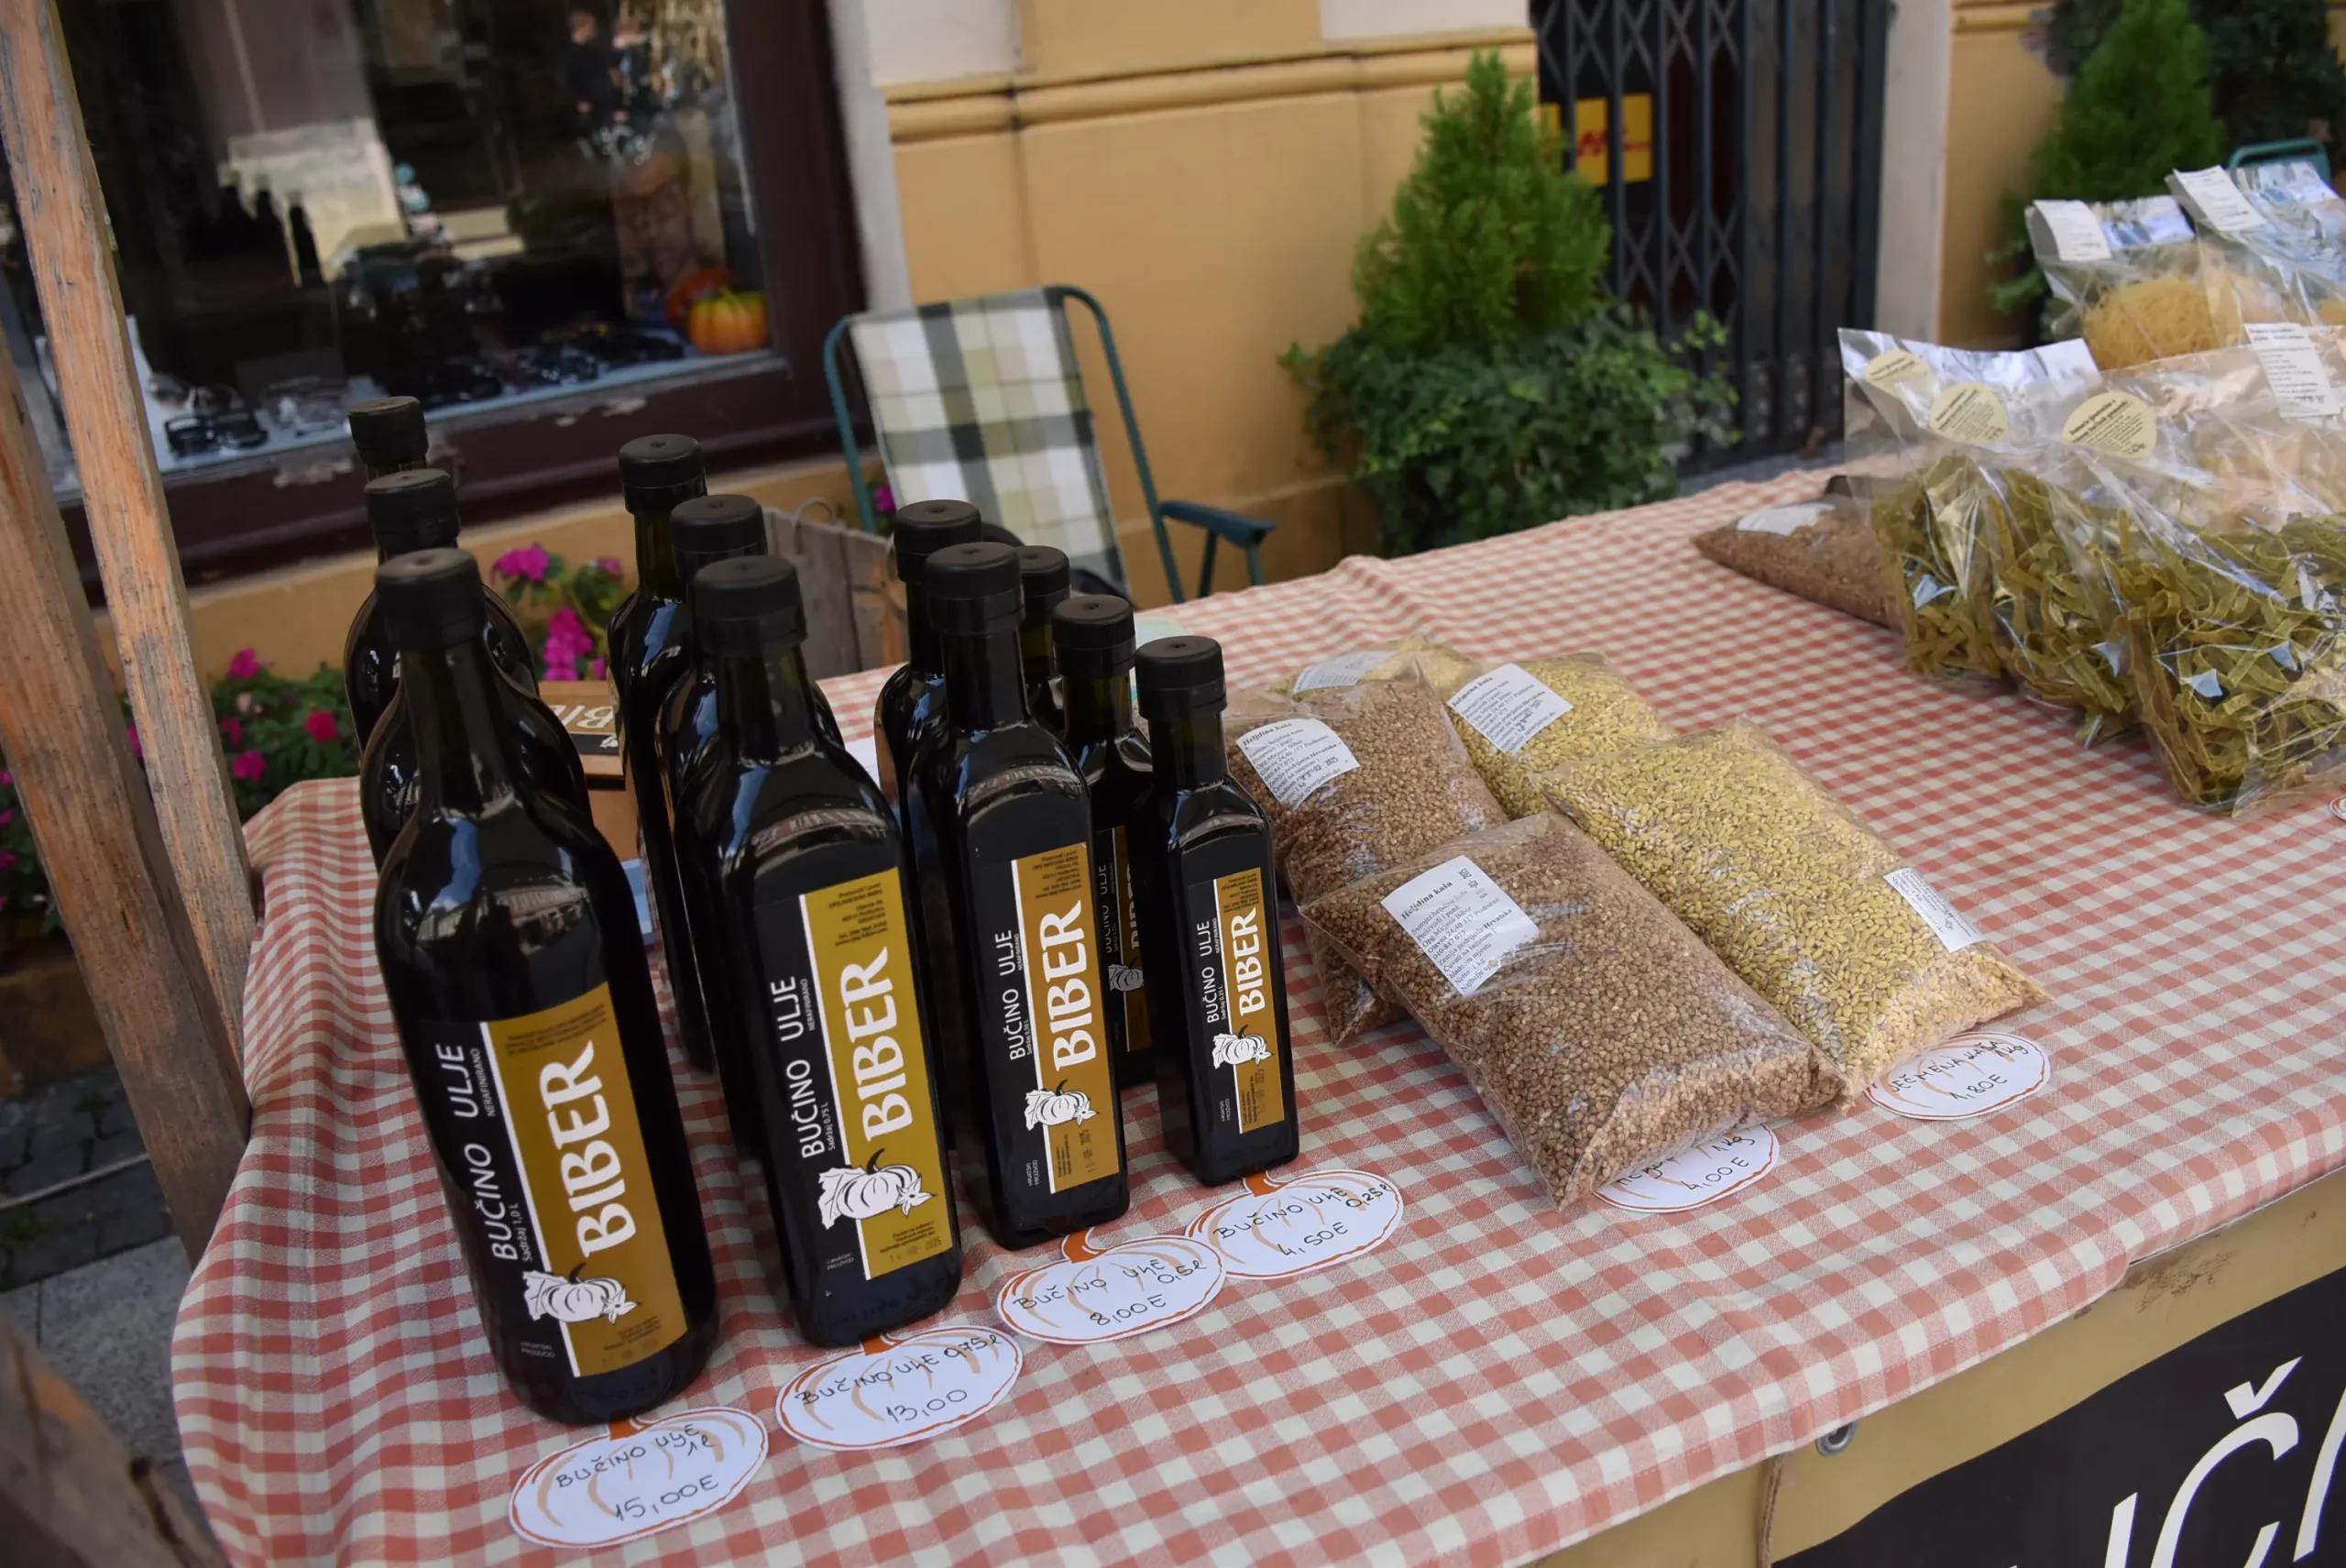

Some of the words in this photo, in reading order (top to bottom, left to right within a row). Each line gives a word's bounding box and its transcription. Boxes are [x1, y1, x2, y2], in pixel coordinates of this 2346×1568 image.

[1242, 727, 1274, 746] Heljdina
[1400, 891, 1434, 920] Heljdina
[1433, 879, 1453, 895] kaša
[1197, 920, 1212, 957] ULJE
[1416, 916, 1442, 941] Proizvodi
[1421, 935, 1436, 948] Opg
[1432, 916, 1456, 937] Mirjana
[1426, 934, 1448, 953] Glavna
[1445, 921, 1463, 937] 24,40
[994, 929, 1015, 976] ULJE
[1231, 906, 1265, 1016] BIBER
[1437, 946, 1458, 966] Zemlja
[1442, 953, 1462, 972] Čuvati
[1461, 948, 1469, 956] na
[1448, 956, 1473, 979] hladnom
[1039, 899, 1096, 1071] BIBER
[1200, 966, 1220, 1024] BUČINO
[1460, 970, 1485, 992] Najbolje
[771, 975, 804, 1042] ULJE
[801, 978, 816, 1031] NERAFINIRANO
[1003, 988, 1026, 1060] BUČINO
[839, 946, 913, 1144] BIBER
[435, 1042, 479, 1119] ULJE
[473, 1047, 497, 1117] NERAFINIRANO
[786, 1058, 825, 1159] BUČINO
[539, 1040, 636, 1258] BIBER
[826, 1124, 836, 1151] Sadržaj
[464, 1143, 519, 1261] BUČINO
[1212, 1203, 1303, 1239] BUČINO
[1012, 1278, 1107, 1310] BUČINO
[794, 1370, 893, 1406] BUČINO
[886, 1388, 968, 1423] 13,00
[555, 1445, 646, 1488] BUČINO
